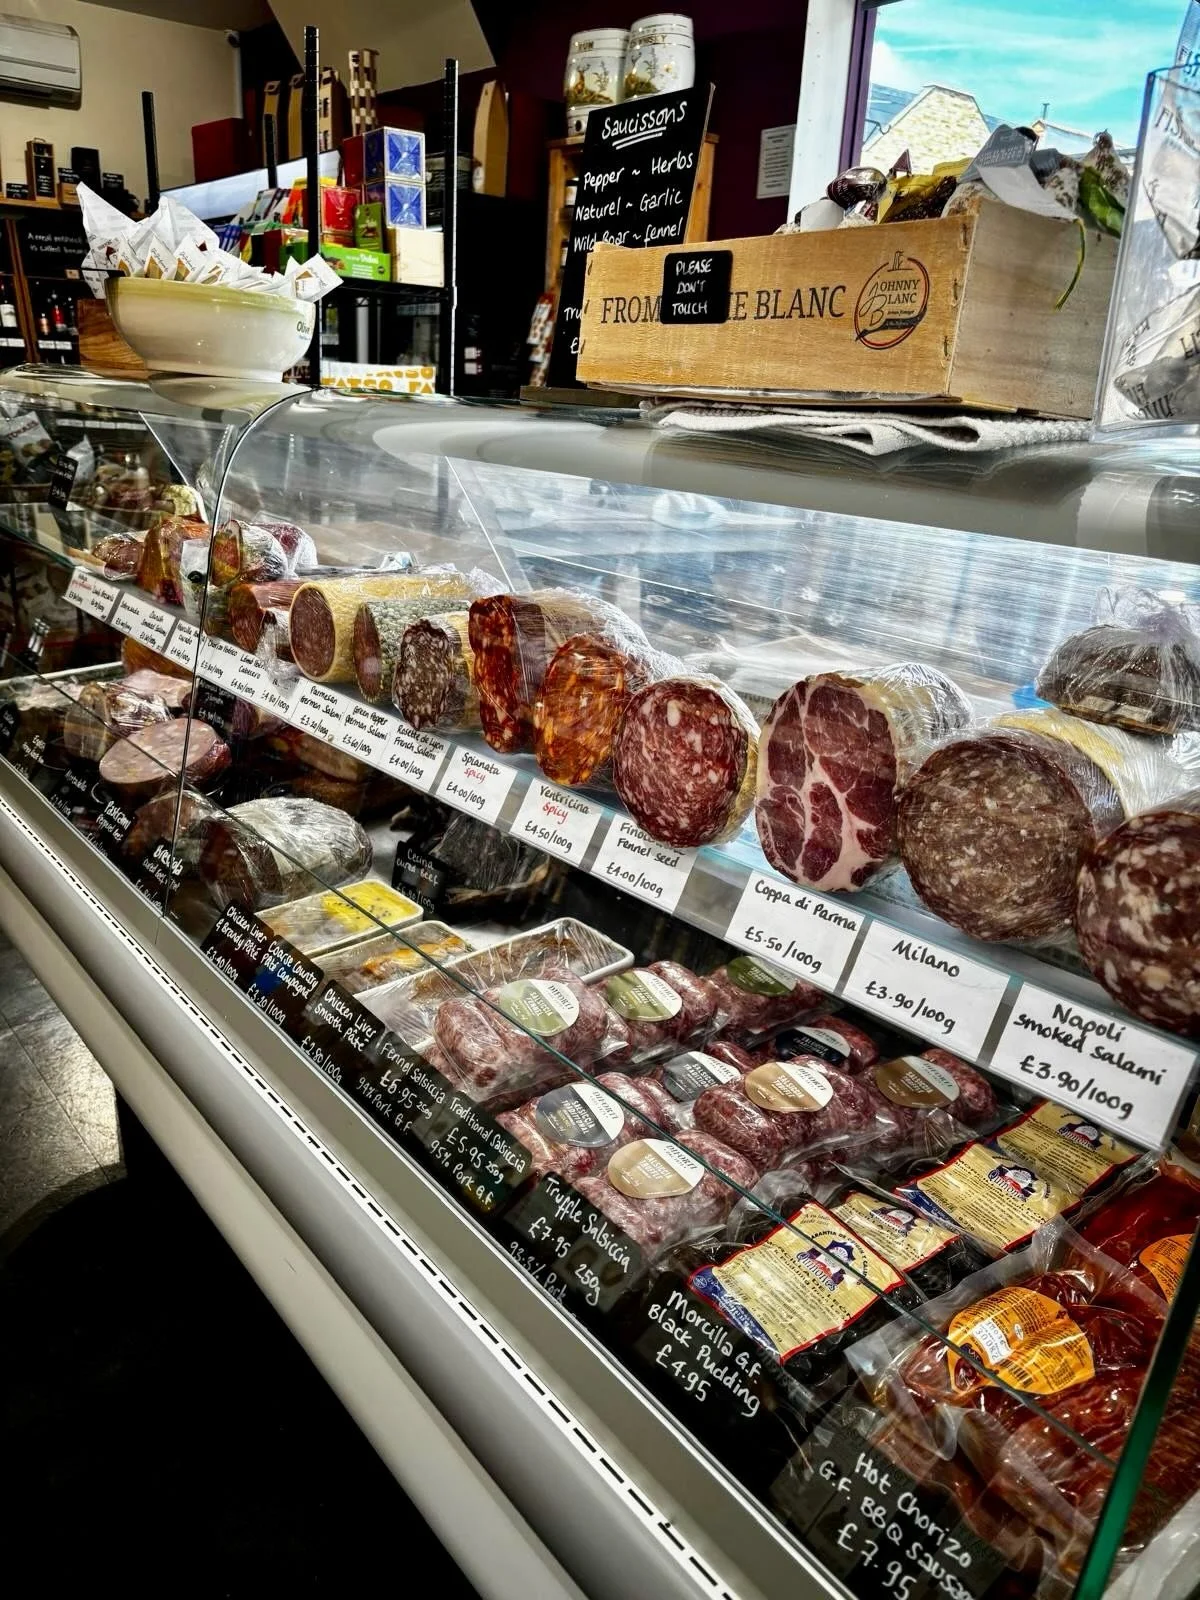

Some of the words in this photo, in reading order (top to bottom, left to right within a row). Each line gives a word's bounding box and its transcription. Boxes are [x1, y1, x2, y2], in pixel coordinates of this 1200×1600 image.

[602, 101, 688, 140] Saucissons
[583, 167, 625, 193] Pepper
[651, 151, 693, 175] Herbs
[575, 196, 621, 221] Naturel
[639, 188, 683, 212] Garlic
[574, 232, 597, 252] Wild
[675, 258, 712, 276] PLEASE
[600, 295, 662, 324] FROM
[753, 285, 847, 320] BLANC
[676, 280, 706, 295] DON'T
[672, 301, 708, 316] TOUCH
[310, 685, 338, 706] Parmesan
[321, 704, 342, 721] Salami
[366, 725, 389, 741] Salami
[420, 733, 429, 743] de
[462, 752, 500, 776] Spianata
[446, 781, 486, 810] £4.00/100g
[540, 785, 590, 815] Ventricina
[525, 820, 573, 854] £4.50/100g
[617, 837, 651, 858] Fennel
[606, 861, 664, 899] £4.00/100g
[226, 906, 250, 932] Chicken
[250, 923, 267, 943] Liver
[754, 879, 792, 907] Coppa
[795, 896, 808, 912] di
[812, 902, 858, 933] Parma
[221, 922, 245, 951] Brandy
[744, 926, 823, 974] £5.50/100g
[268, 940, 294, 967] Coarse
[292, 960, 319, 992] Country
[891, 939, 961, 977] Milano
[324, 988, 353, 1021] Chicken
[354, 1013, 377, 1038] Liver
[865, 980, 956, 1035] £3.90/100g
[1052, 1003, 1127, 1042] Napoli
[1013, 1013, 1087, 1054] smoked
[380, 1042, 414, 1075] Fennel
[410, 1068, 446, 1105] Salsiccia
[1019, 1055, 1134, 1121] £3.90/100g
[371, 1093, 393, 1118] Pork
[449, 1096, 494, 1142] Traditional
[489, 1133, 527, 1174] Salsiccia
[430, 1139, 453, 1168] 95%
[452, 1162, 476, 1191] Pork
[446, 1127, 487, 1169] £5.95
[484, 1160, 505, 1185] 250g
[545, 1176, 583, 1223] Truffle
[581, 1212, 631, 1273] Salsiccia
[527, 1216, 571, 1258] £7.95
[574, 1263, 601, 1307] 250g
[666, 1289, 734, 1357] Morcilla
[647, 1303, 693, 1348] Black
[695, 1344, 761, 1418] Pudding
[655, 1343, 711, 1402] £4.95
[855, 1451, 892, 1495] Hot
[896, 1491, 972, 1569] Chorizo
[859, 1495, 904, 1547] BBQ
[836, 1522, 918, 1600] £7.95
